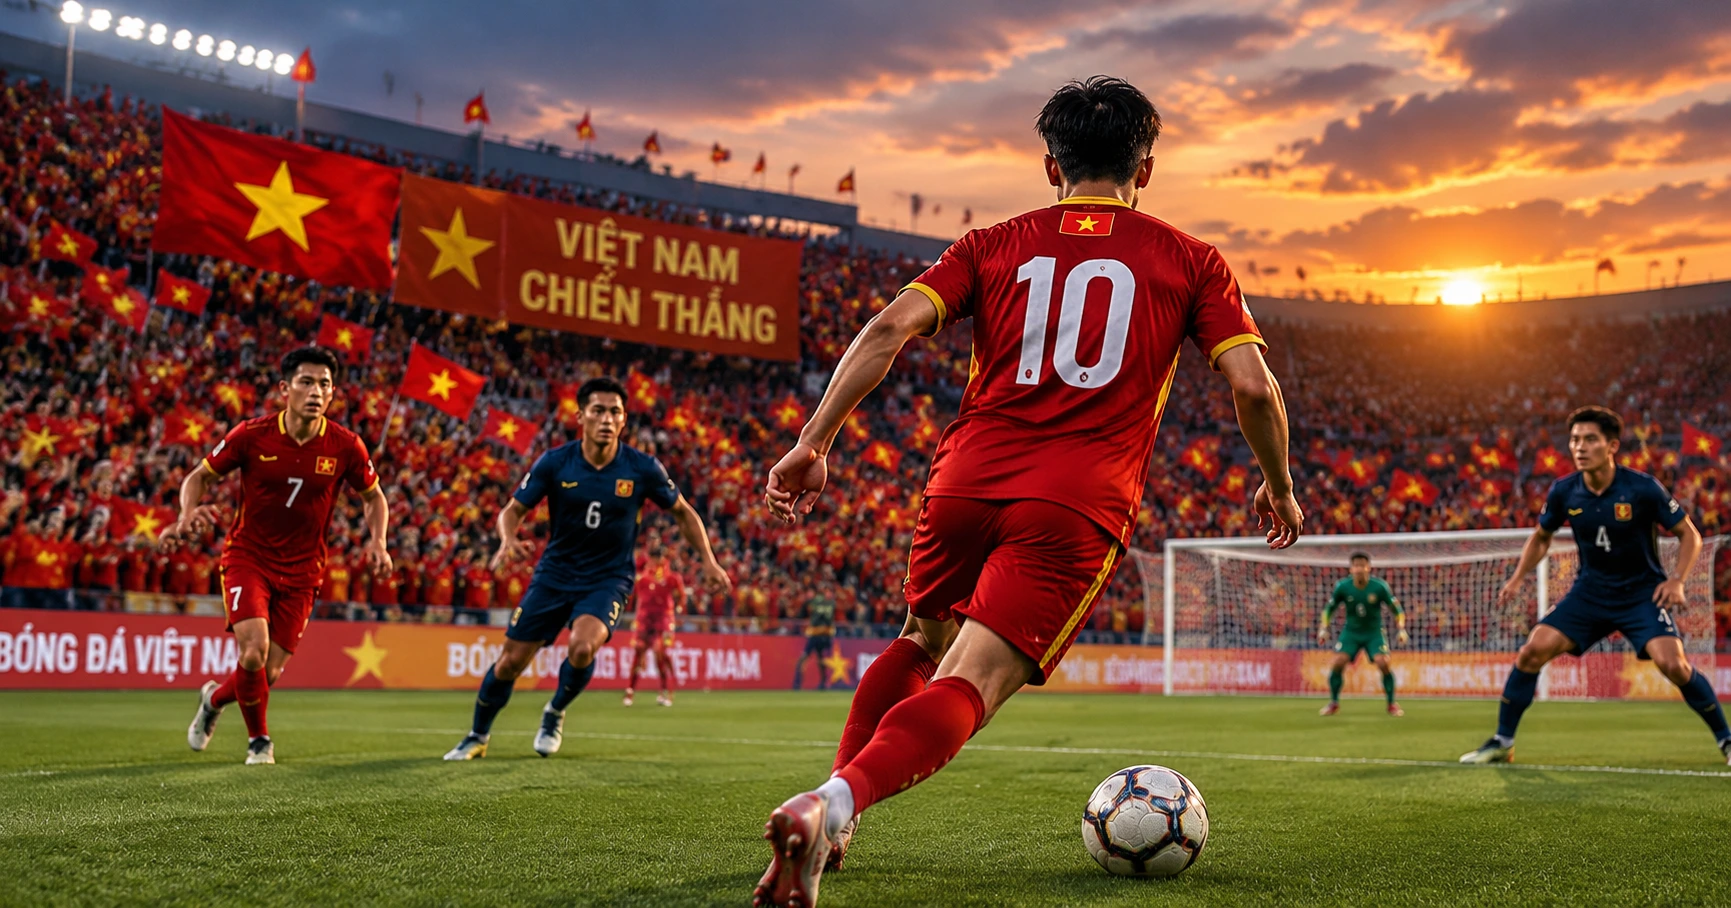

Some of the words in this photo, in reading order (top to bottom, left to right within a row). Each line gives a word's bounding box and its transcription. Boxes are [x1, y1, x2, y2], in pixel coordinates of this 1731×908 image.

[555, 217, 643, 270] VIỆT
[653, 235, 739, 285] NAM
[1015, 255, 1136, 389] 10
[286, 477, 303, 508] 7
[585, 501, 601, 529] 6
[1595, 525, 1611, 552] 4
[230, 586, 242, 611] 7
[0, 622, 78, 673] BÓNG
[134, 627, 198, 682] VIỆT
[200, 636, 239, 675] NA
[706, 648, 762, 681] NAM
